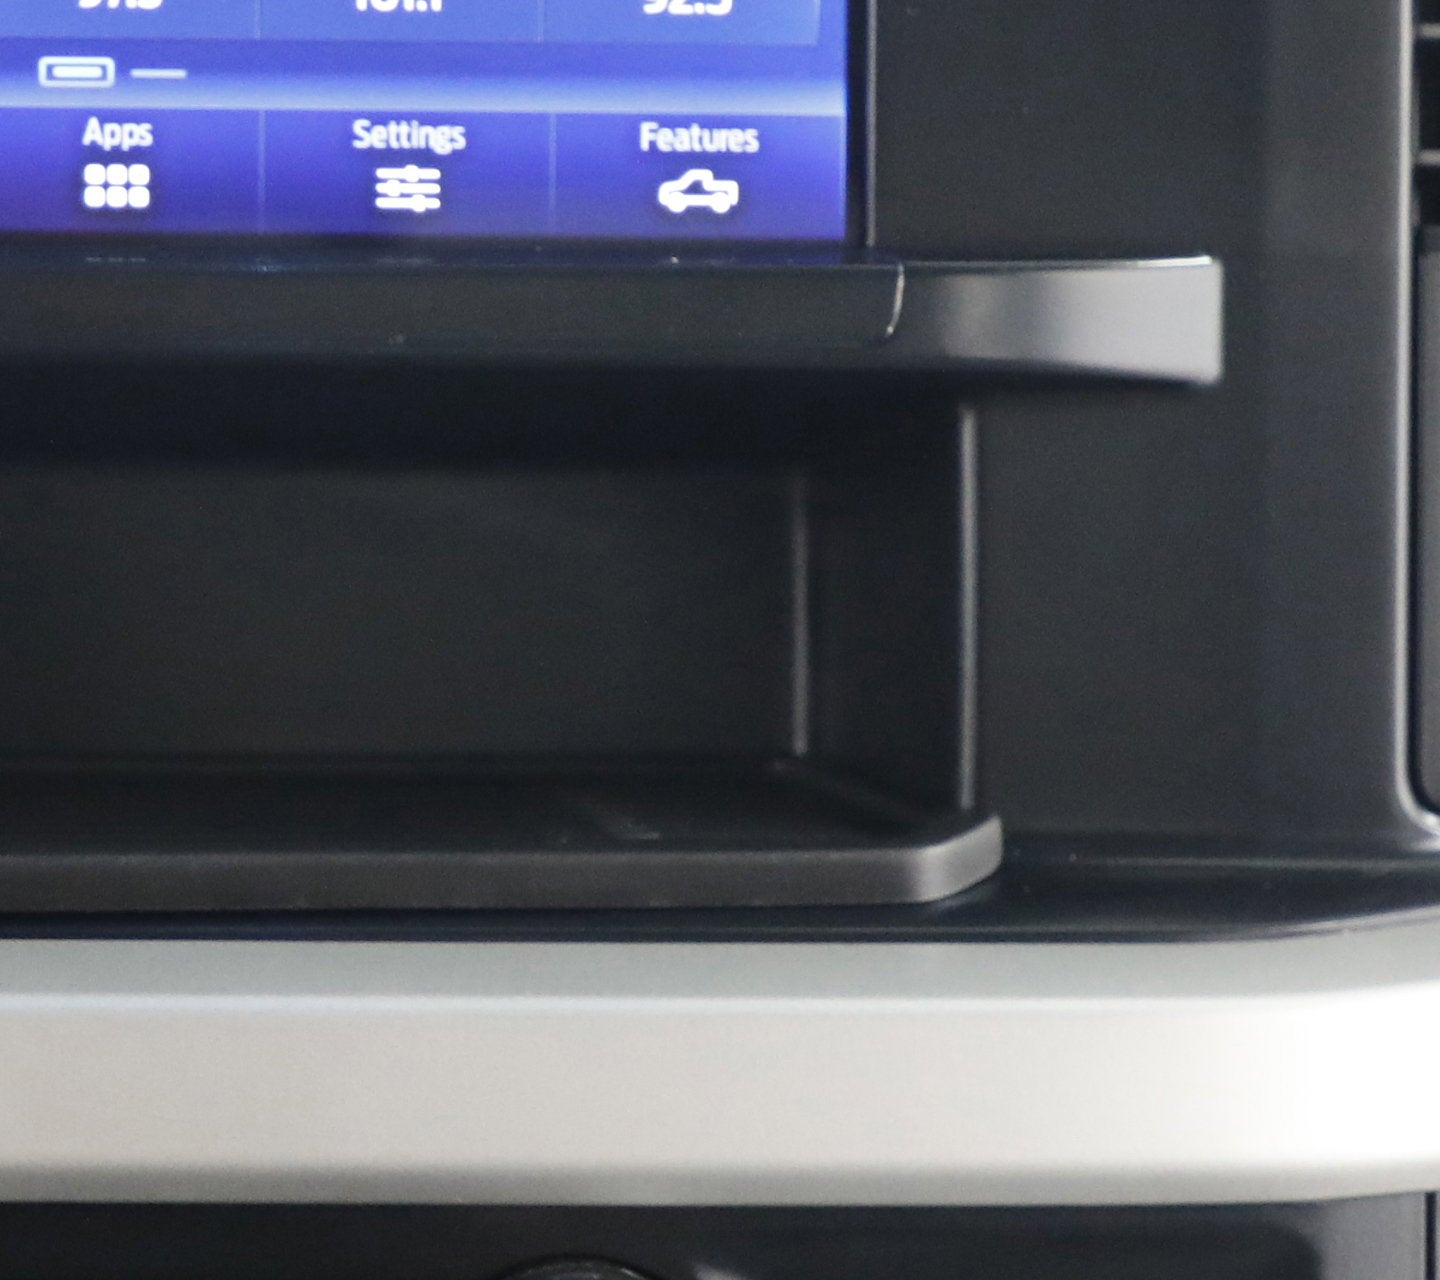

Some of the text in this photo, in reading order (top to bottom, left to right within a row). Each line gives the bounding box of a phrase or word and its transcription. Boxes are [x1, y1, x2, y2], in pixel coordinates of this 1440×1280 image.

[83, 117, 154, 149] Apps
[352, 119, 467, 155] Settings
[639, 121, 760, 154] Features
